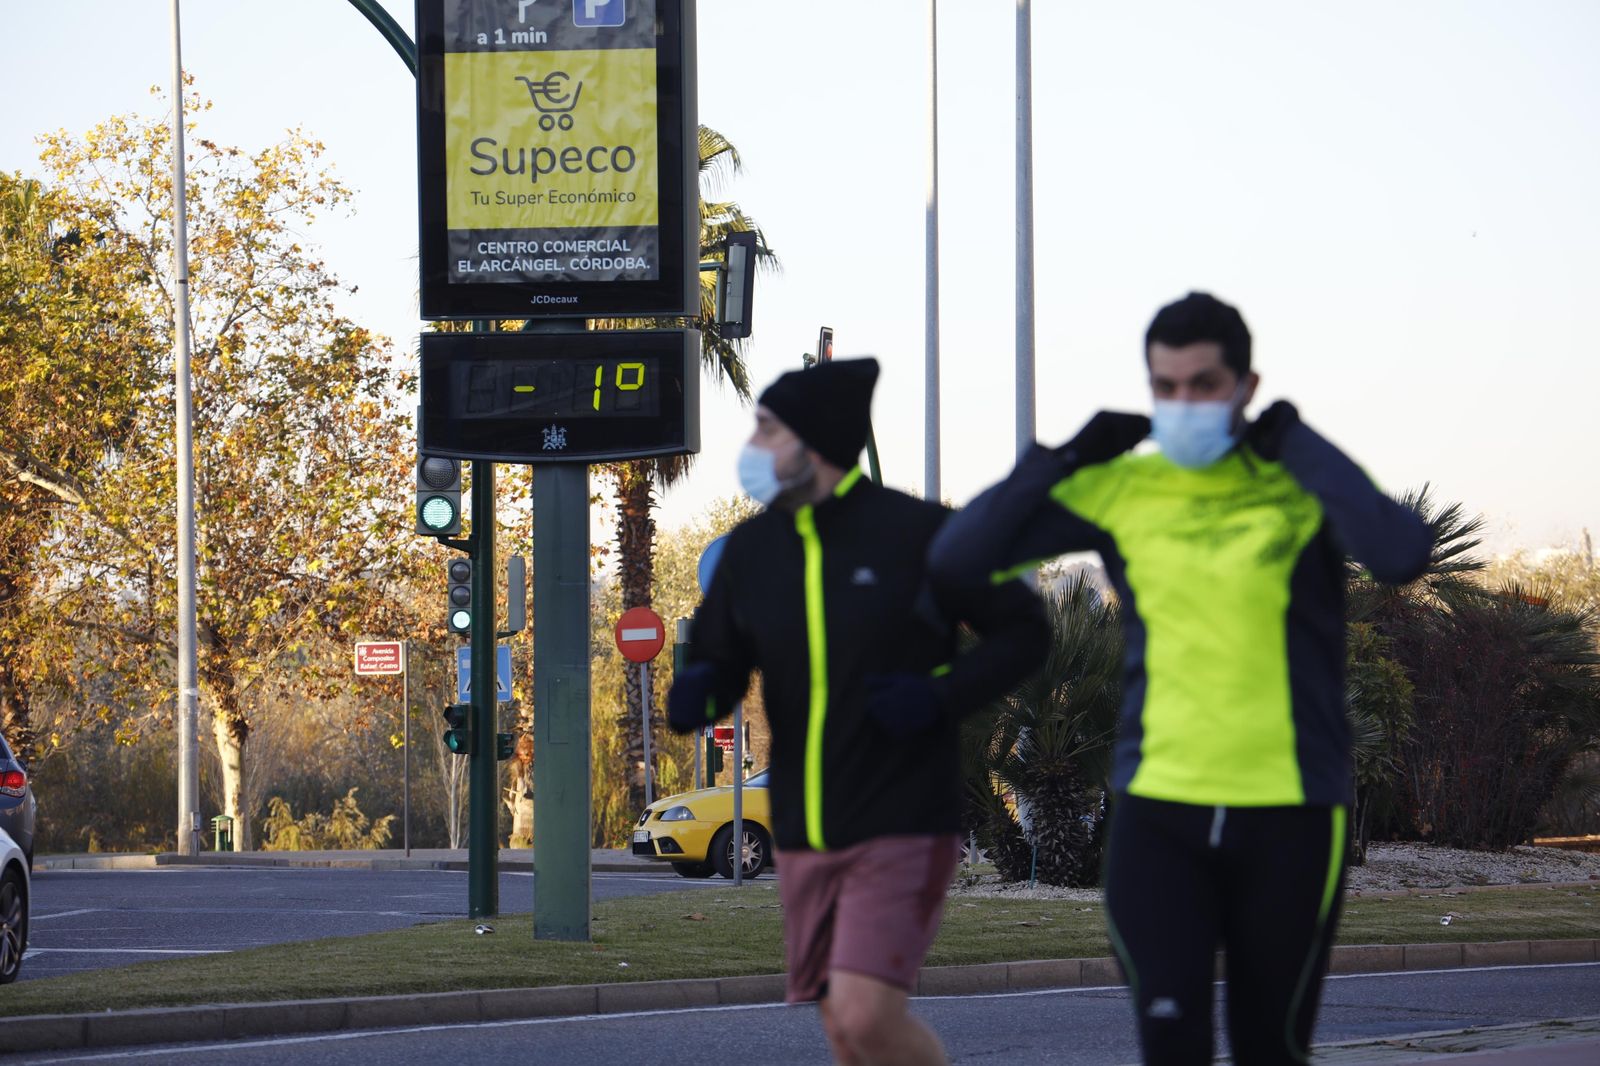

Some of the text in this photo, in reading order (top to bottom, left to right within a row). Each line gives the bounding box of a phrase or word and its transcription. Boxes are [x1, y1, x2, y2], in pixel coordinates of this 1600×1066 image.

[477, 26, 548, 45] a 1 min
[470, 137, 636, 184] Supeco
[470, 188, 636, 207] Tu Super Económico
[477, 239, 631, 255] CENTRO COMERCIAL
[458, 255, 650, 272] EL ARCÁNGEL. CÓRDOBA.
[530, 295, 578, 304] JCDecaux
